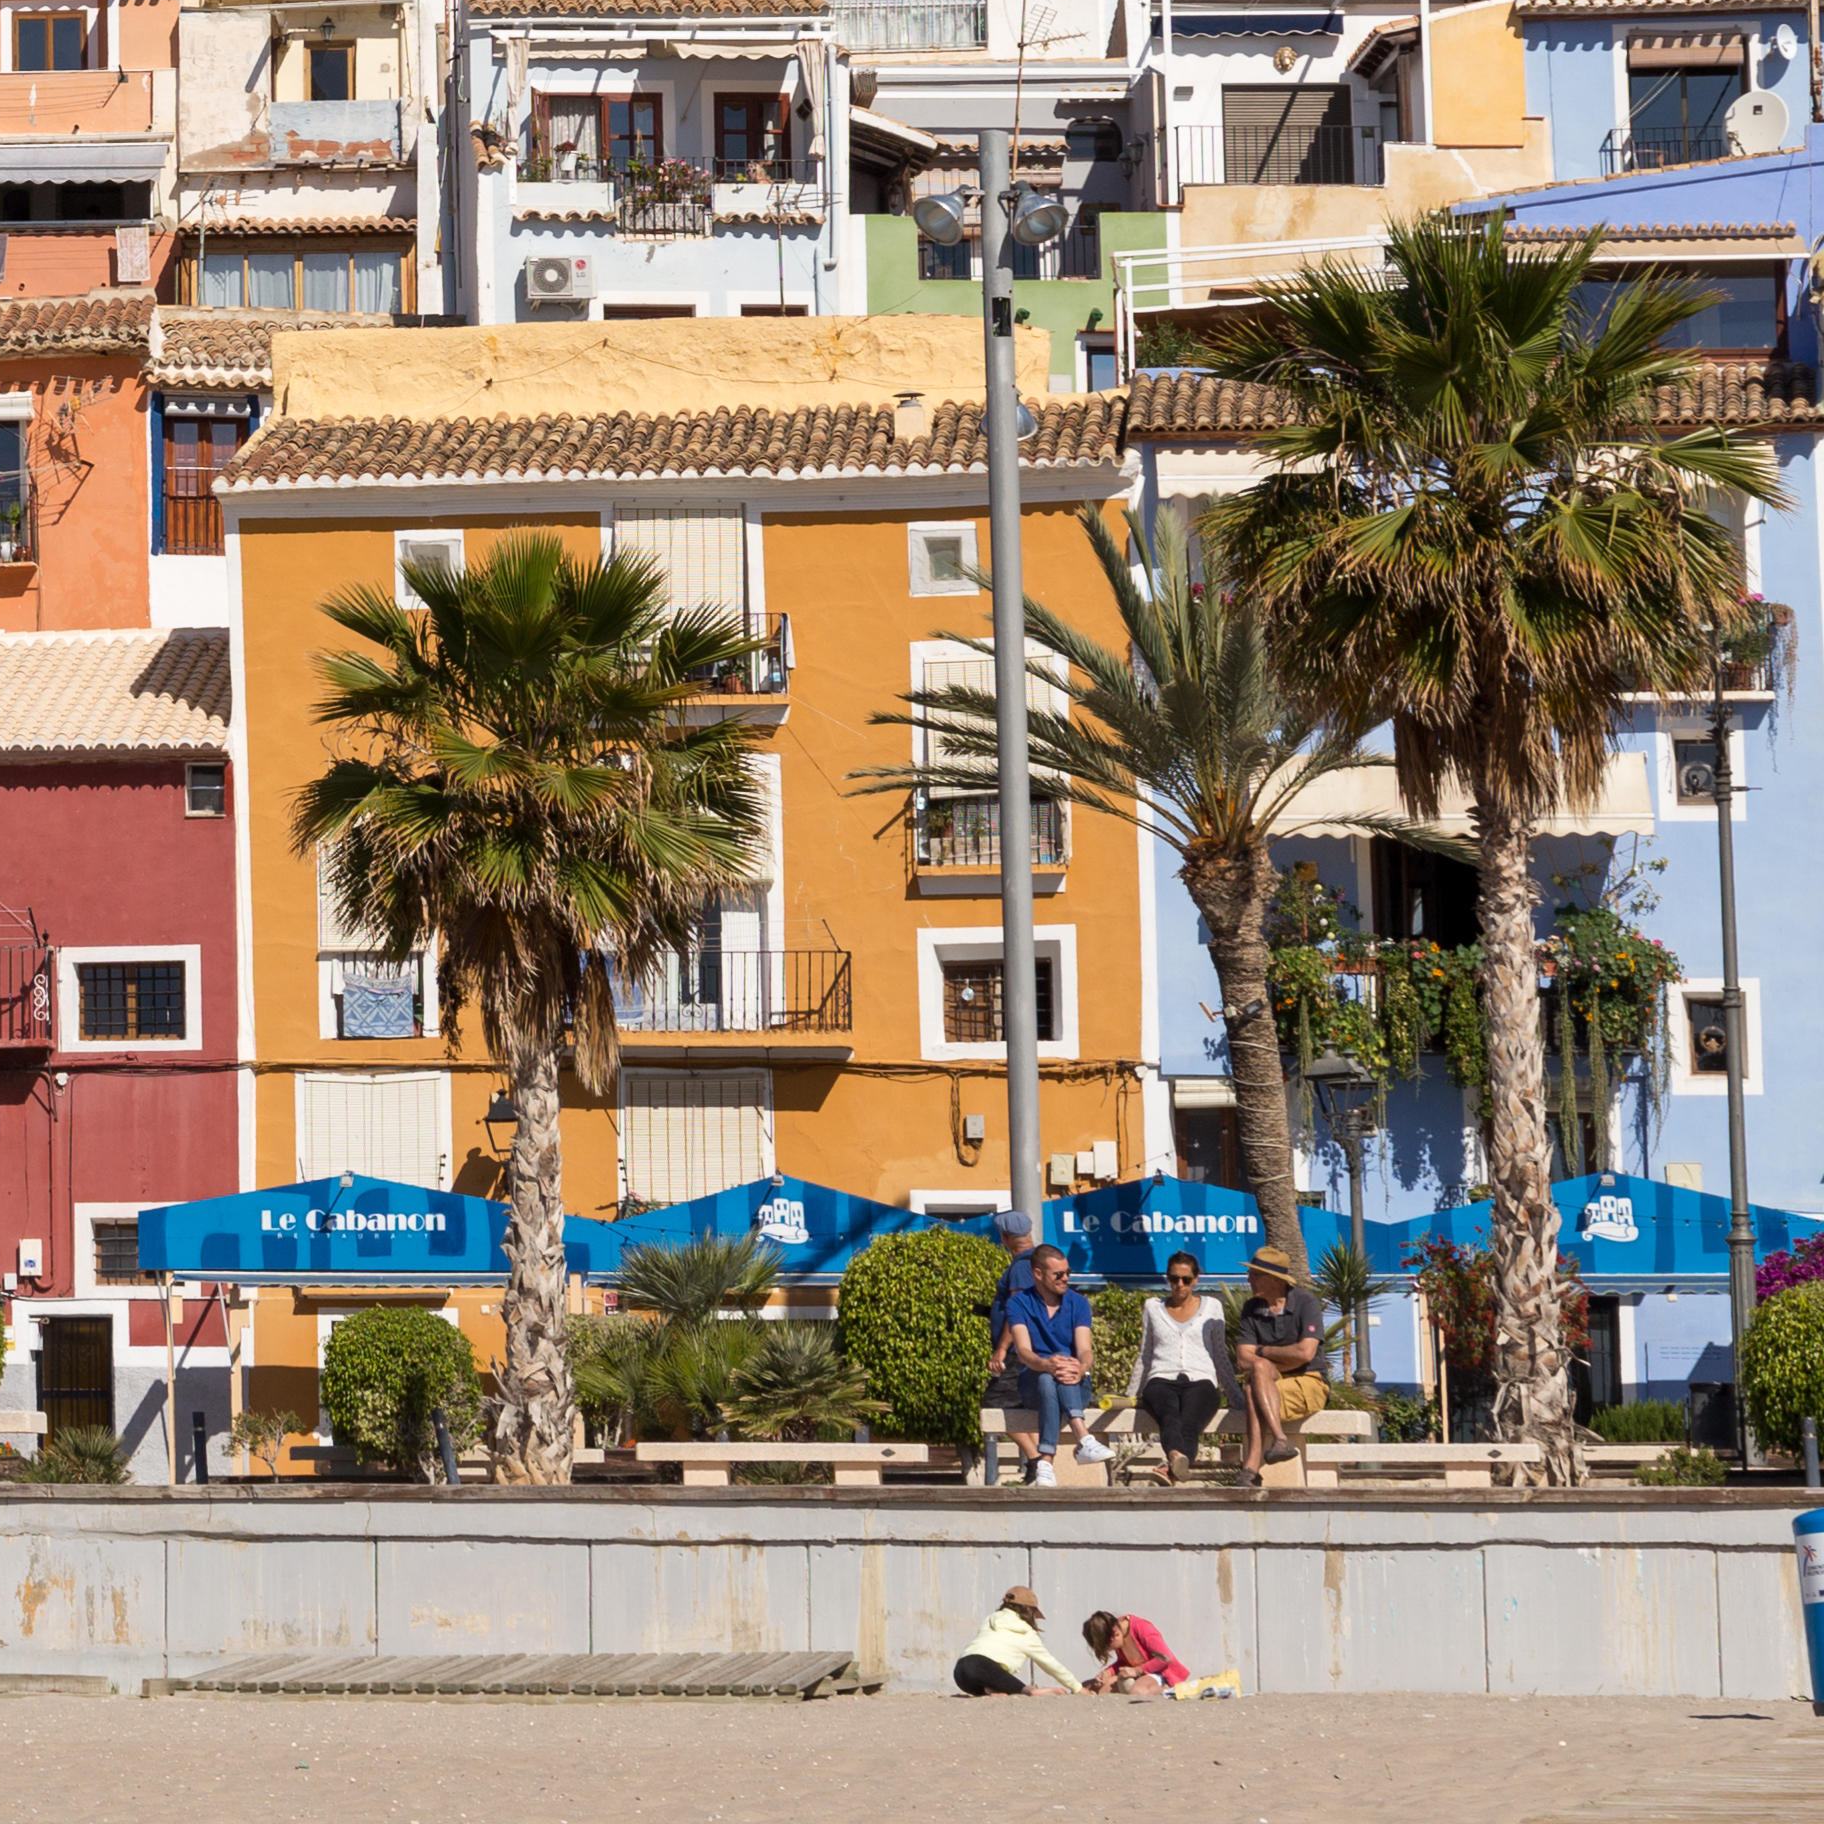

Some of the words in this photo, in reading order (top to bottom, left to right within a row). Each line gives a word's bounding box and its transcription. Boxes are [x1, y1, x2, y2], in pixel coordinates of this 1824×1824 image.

[261, 1210, 297, 1231] Le
[306, 1209, 446, 1231] Cabanon
[1063, 1211, 1100, 1233] Le
[1110, 1211, 1258, 1234] Cabanon
